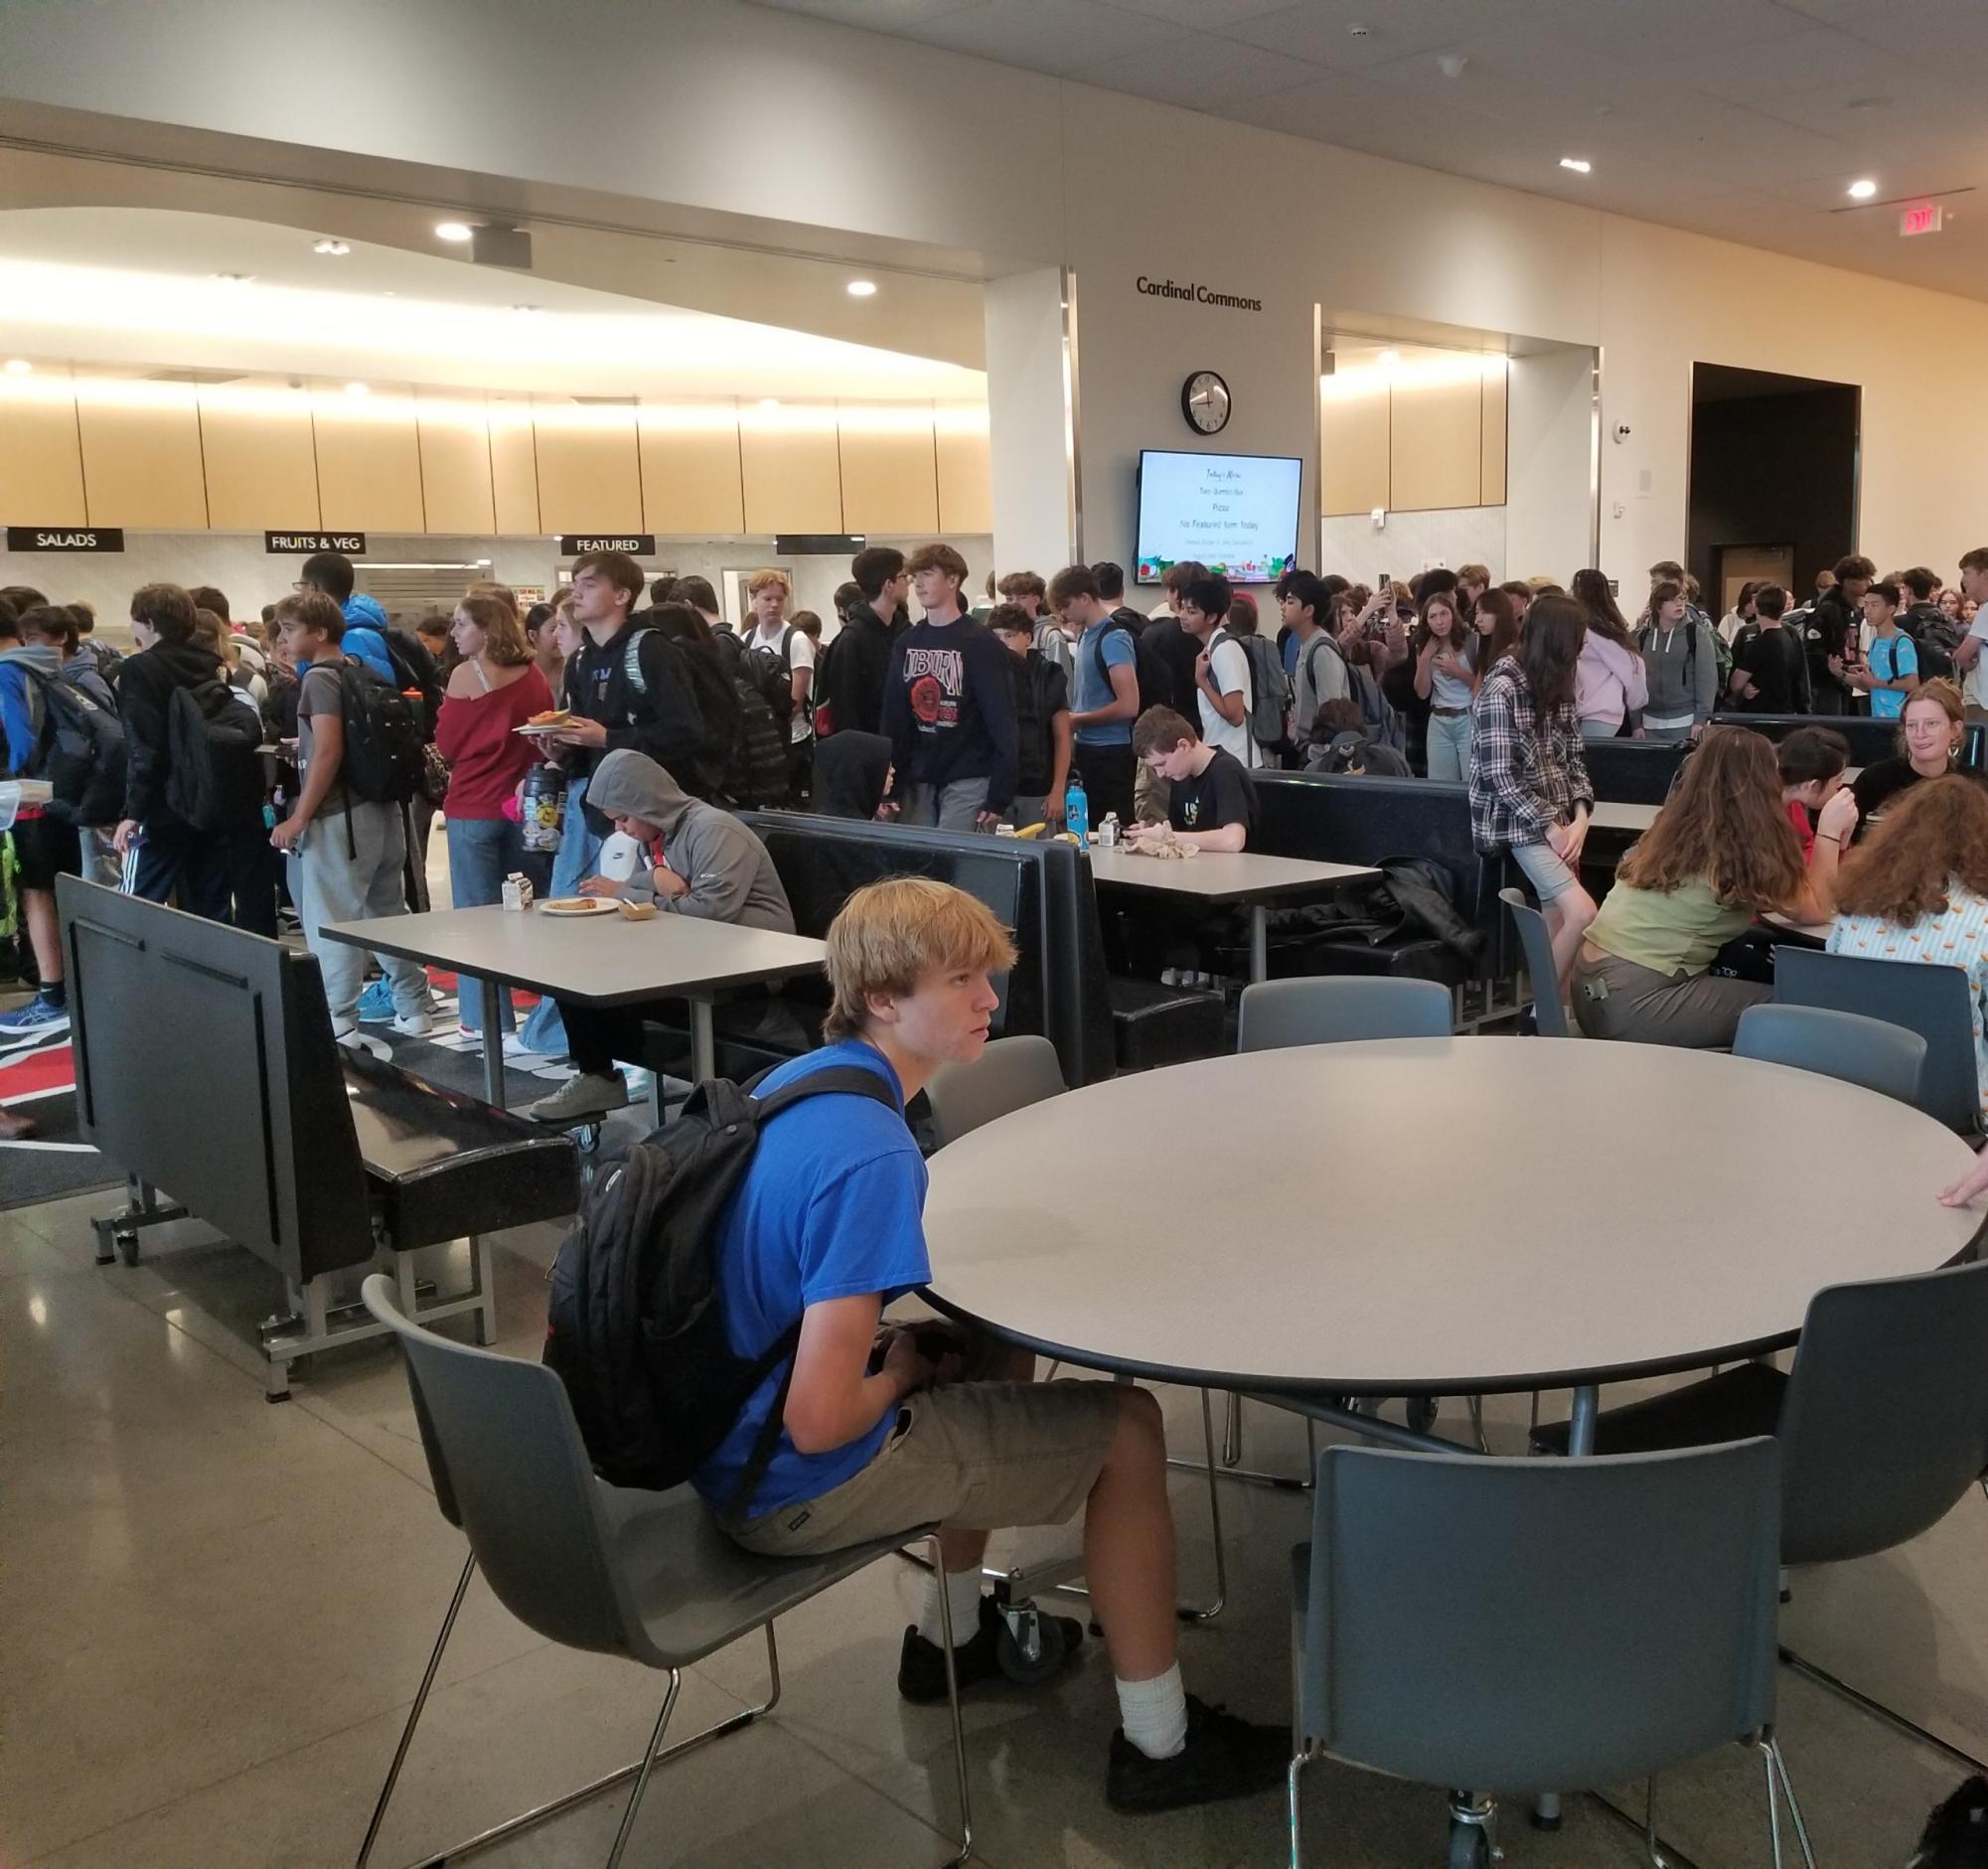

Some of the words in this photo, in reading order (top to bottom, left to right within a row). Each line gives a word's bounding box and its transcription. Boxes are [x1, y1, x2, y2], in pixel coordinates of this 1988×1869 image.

[1137, 276, 1194, 301] Cardinal
[1196, 286, 1262, 311] Commons
[37, 534, 96, 546] SALADS
[271, 537, 316, 548] FRUITS
[320, 538, 330, 548] &
[333, 538, 360, 549] VEG
[576, 540, 639, 551] FEATURED
[903, 648, 964, 697] UBURN
